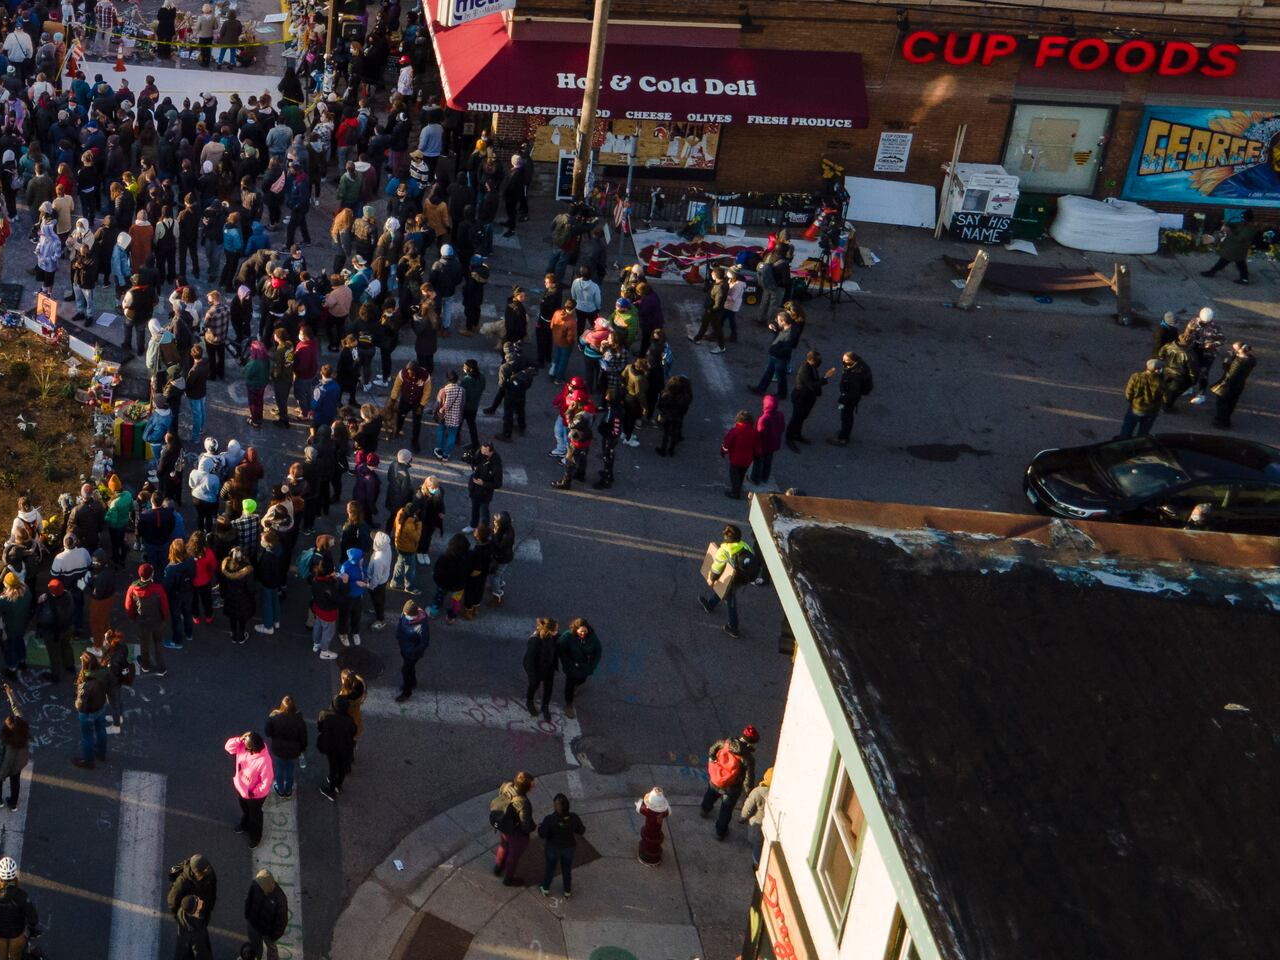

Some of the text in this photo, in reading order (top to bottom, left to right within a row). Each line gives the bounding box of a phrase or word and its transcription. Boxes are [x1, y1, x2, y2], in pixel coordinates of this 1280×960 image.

[902, 30, 1241, 80] CUP FOODS
[556, 73, 758, 96] Ho & Cold Deli
[467, 102, 514, 113] MIDDLE
[517, 106, 573, 117] EASTERN
[625, 111, 672, 120] CHEESE
[687, 113, 732, 123] OLIVES
[747, 115, 788, 125] FRESH
[791, 117, 853, 128] PRODUCE
[1139, 118, 1263, 176] GEORGE
[957, 214, 1010, 230] SAY HIS
[962, 227, 1004, 243] NAME
